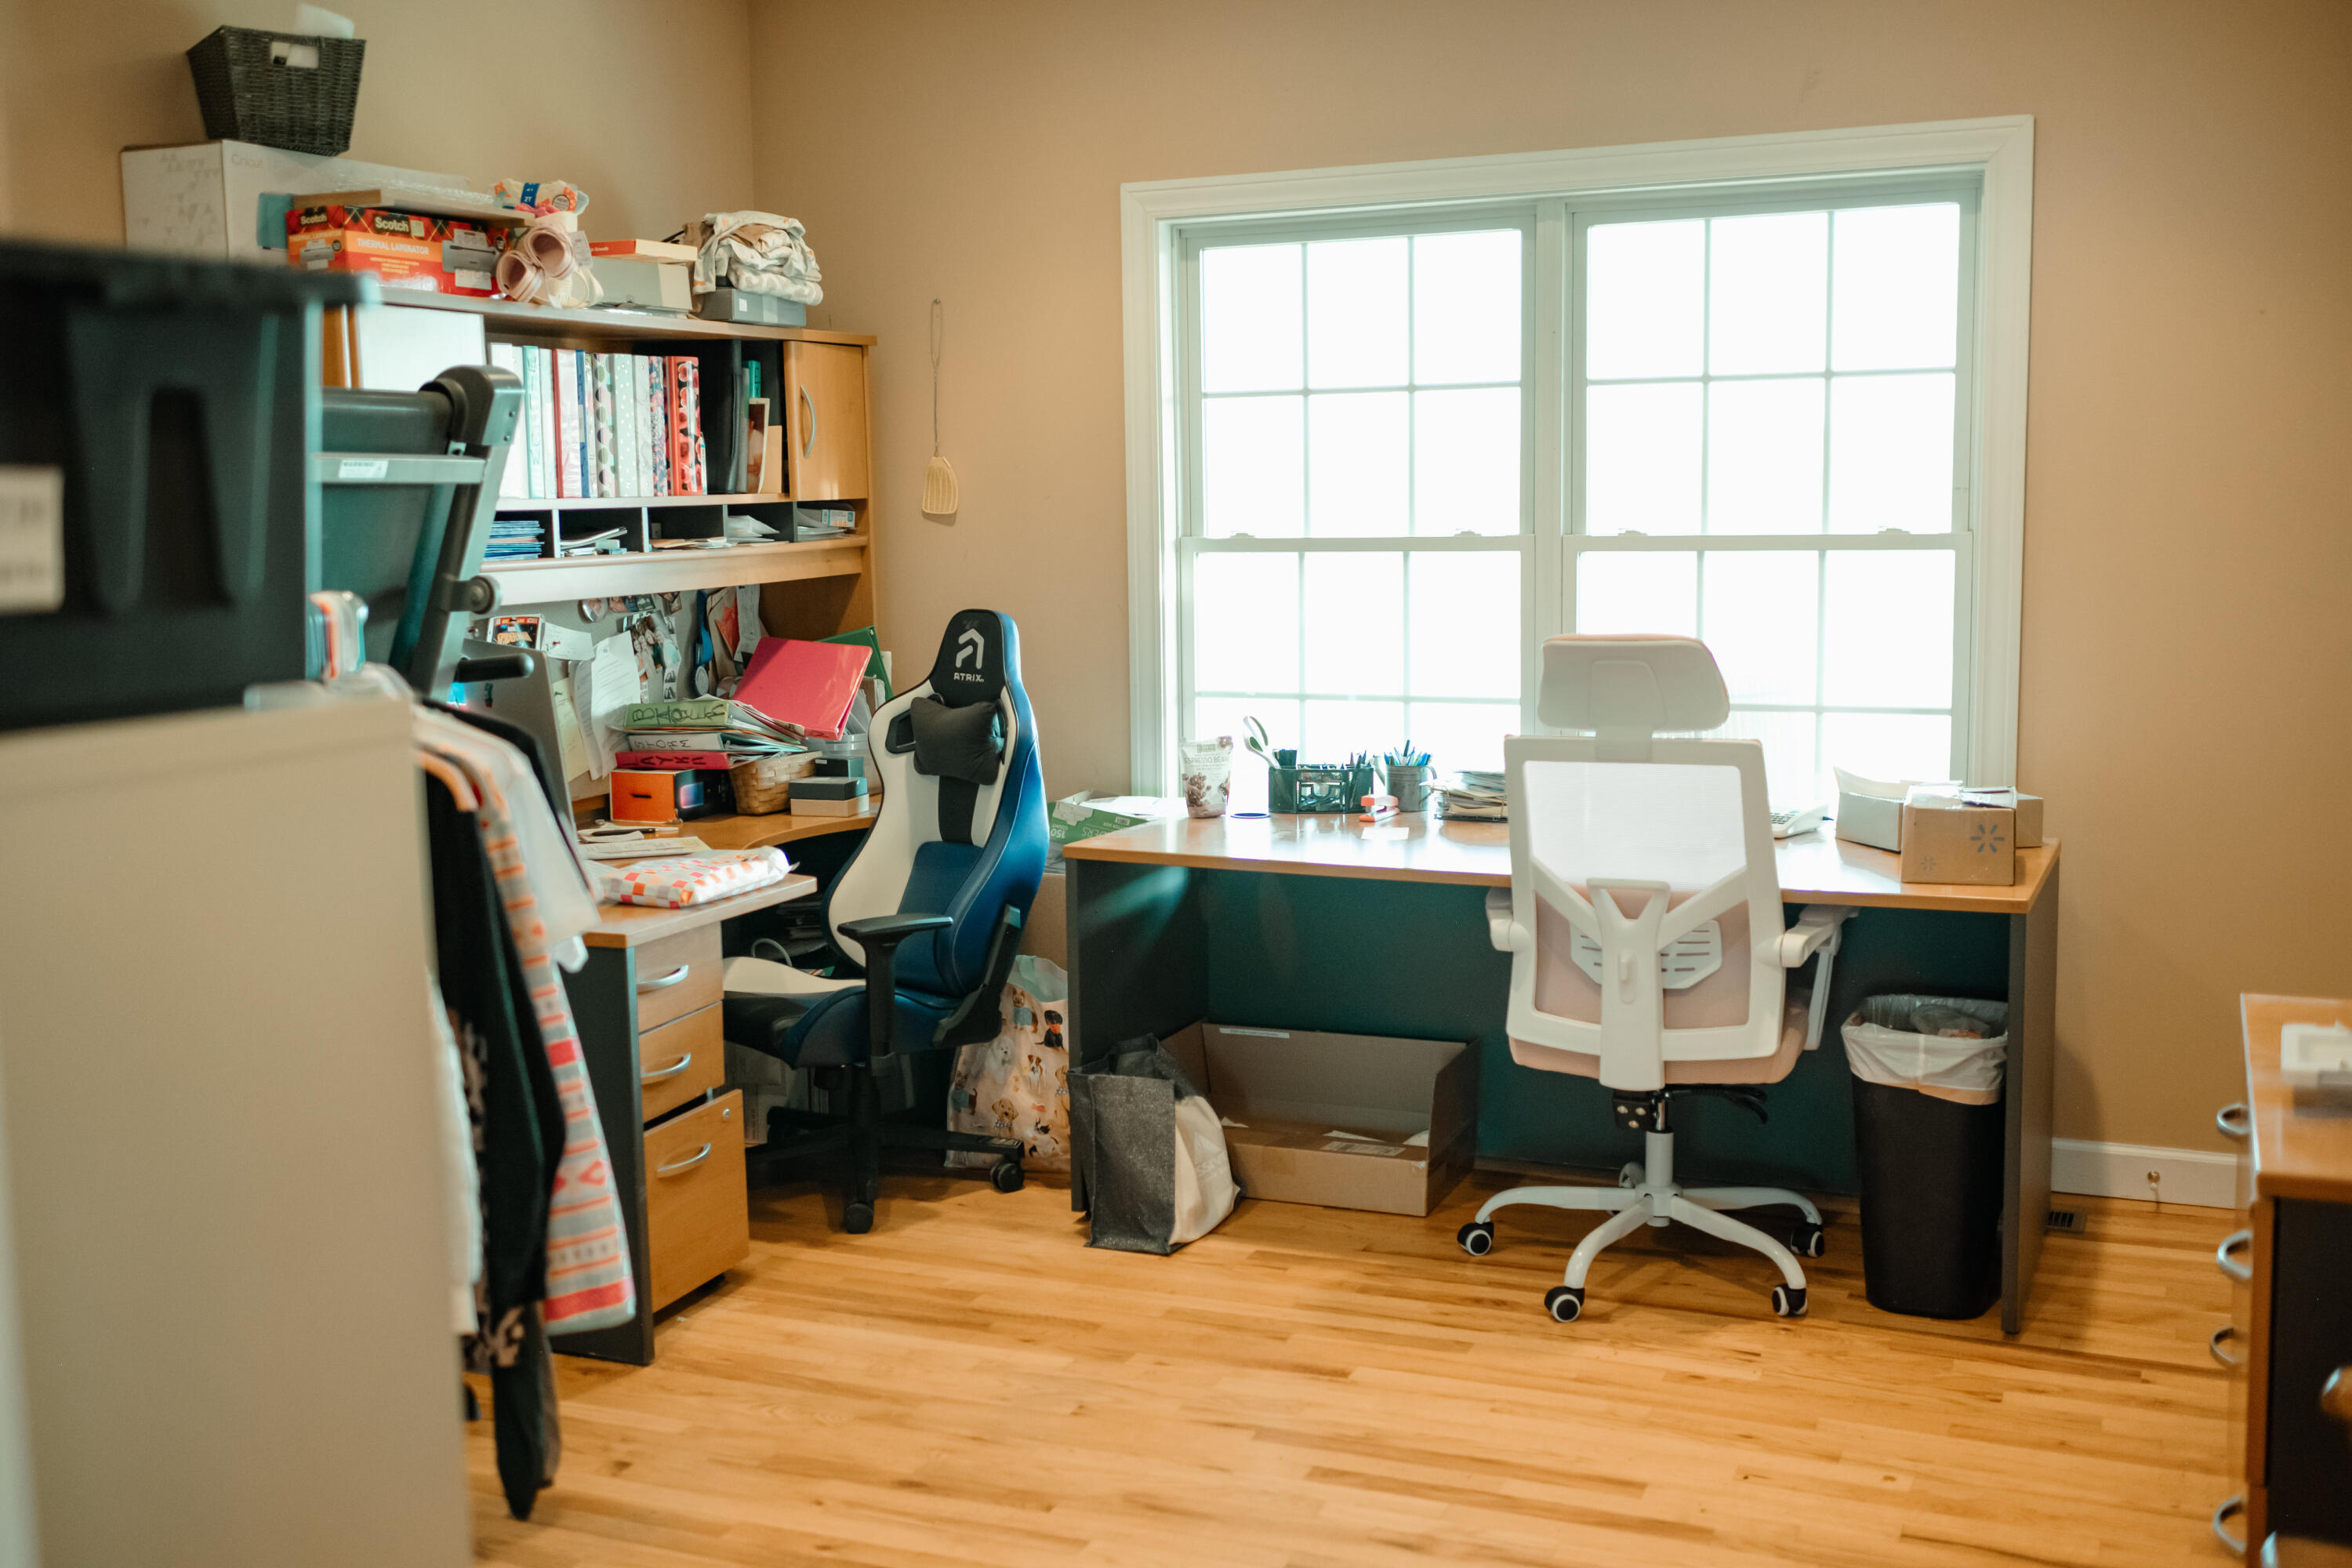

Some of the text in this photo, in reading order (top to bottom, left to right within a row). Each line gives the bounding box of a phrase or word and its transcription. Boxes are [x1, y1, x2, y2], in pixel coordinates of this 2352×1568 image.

[300, 213, 328, 225] Scotch
[375, 216, 409, 233] Scotch
[358, 238, 430, 255] THERMAL LAMINATOR
[953, 672, 982, 682] ATRIX
[633, 739, 691, 750] STORM
[1051, 828, 1066, 839] 150
